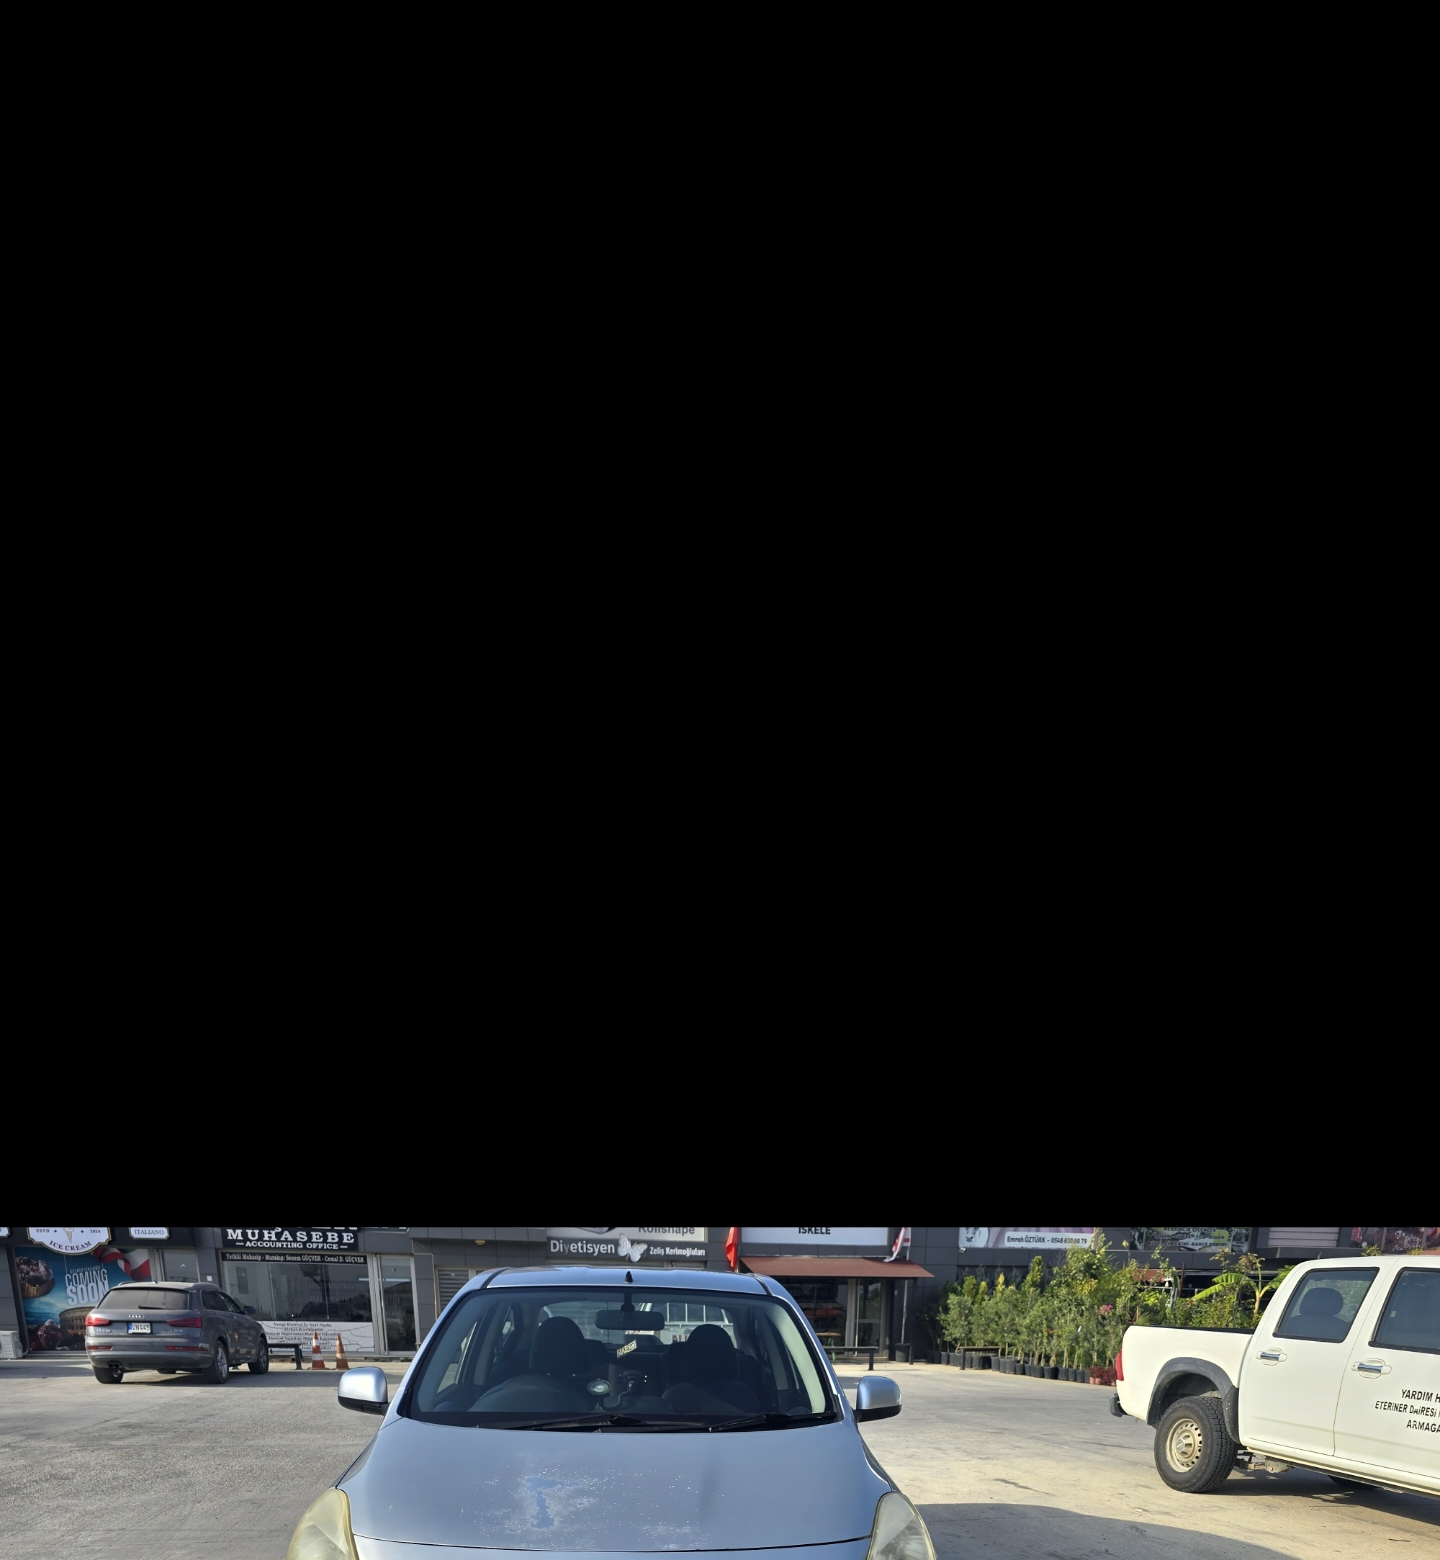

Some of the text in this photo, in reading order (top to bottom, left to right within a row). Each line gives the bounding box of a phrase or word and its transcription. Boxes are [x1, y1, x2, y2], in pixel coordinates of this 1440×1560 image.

[226, 1229, 355, 1243] MUHASEBE
[1024, 1235, 1046, 1243] ÖZTÜRK
[49, 1240, 92, 1251] ICE CREAM
[245, 1241, 303, 1249] ACCOUNTING
[550, 1240, 615, 1256] Diyetisyen
[65, 1268, 108, 1287] COMING
[66, 1281, 109, 1306] SOON
[1401, 1388, 1433, 1402] YARDIM
